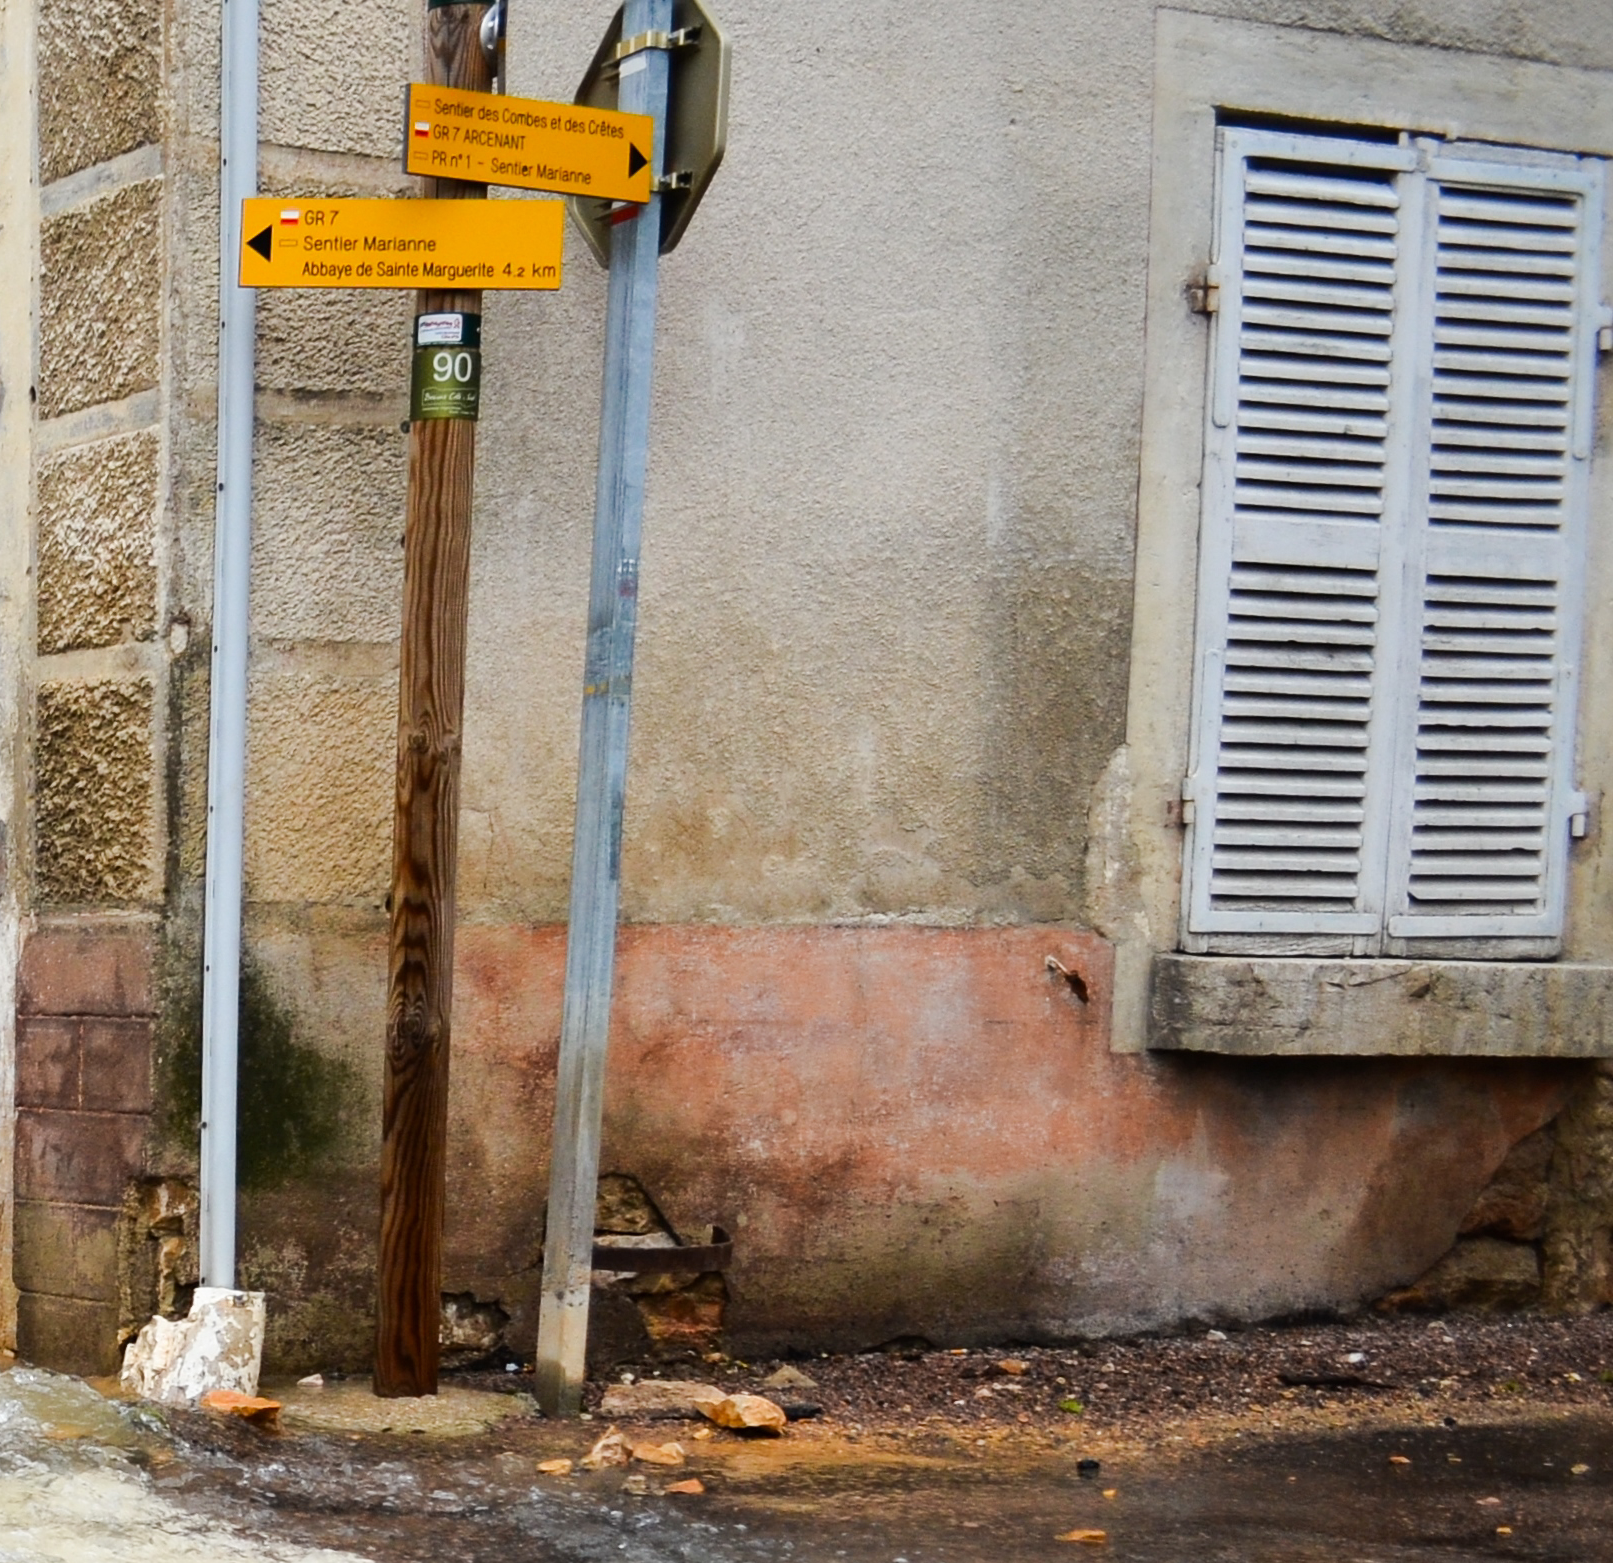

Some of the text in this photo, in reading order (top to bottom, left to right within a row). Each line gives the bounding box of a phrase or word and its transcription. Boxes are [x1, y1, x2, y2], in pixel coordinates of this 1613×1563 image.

[434, 98, 624, 139] Sentier des Combes et des Crêtes
[433, 124, 526, 151] GR 7 ARCENANT
[431, 149, 448, 167] PR
[491, 158, 533, 178] Sentier
[536, 163, 591, 185] Marianne
[304, 210, 340, 226] GR 7
[303, 236, 437, 252] Sentier Marianne
[302, 262, 352, 280] Abbaye
[355, 262, 372, 277] de
[376, 262, 419, 277] Sainte
[422, 262, 494, 281] Marguerite
[532, 263, 556, 278] km
[433, 352, 472, 382] 90
